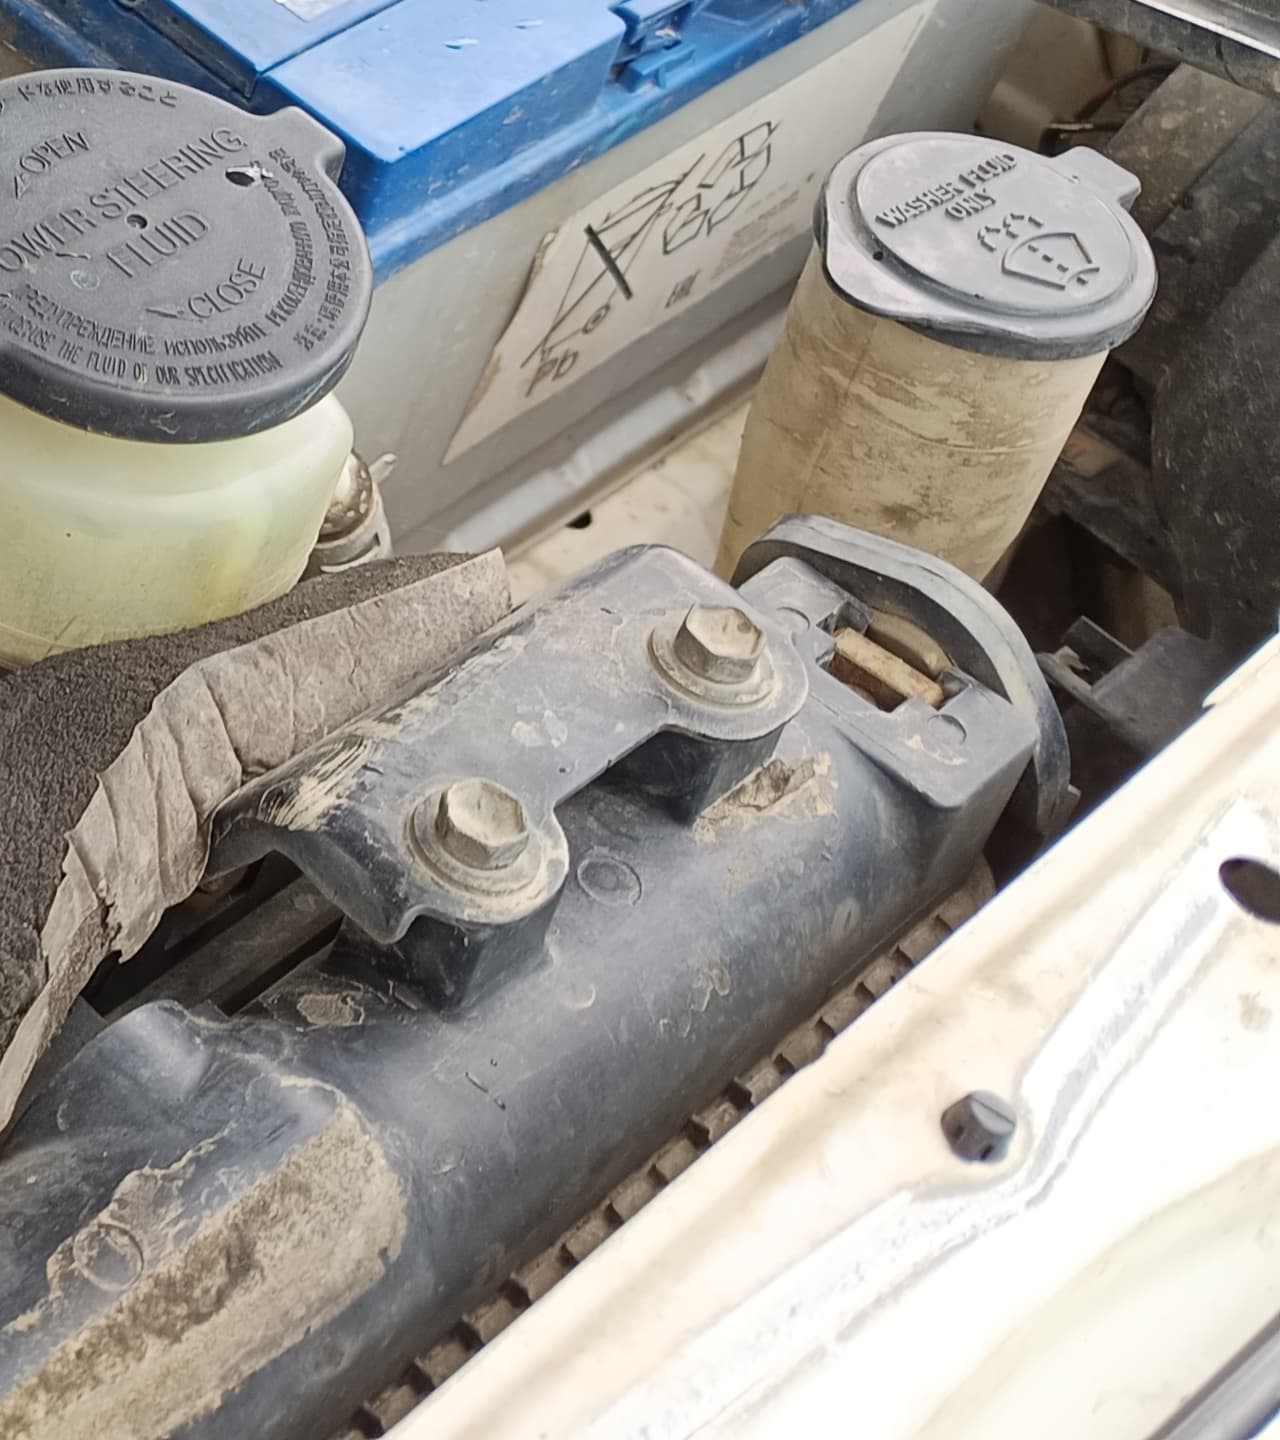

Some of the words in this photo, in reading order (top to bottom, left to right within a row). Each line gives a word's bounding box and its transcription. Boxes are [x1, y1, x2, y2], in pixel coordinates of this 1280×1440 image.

[19, 131, 90, 174] OPEN
[89, 127, 247, 219] STEERING
[874, 181, 965, 229] WASHER
[958, 153, 1017, 189] FLUID
[944, 186, 997, 221] ONLY
[106, 212, 210, 278] FLUID
[187, 257, 266, 319] CLOSE
[57, 339, 84, 364] THE
[87, 351, 126, 378] FLUID
[155, 365, 181, 385] OUR
